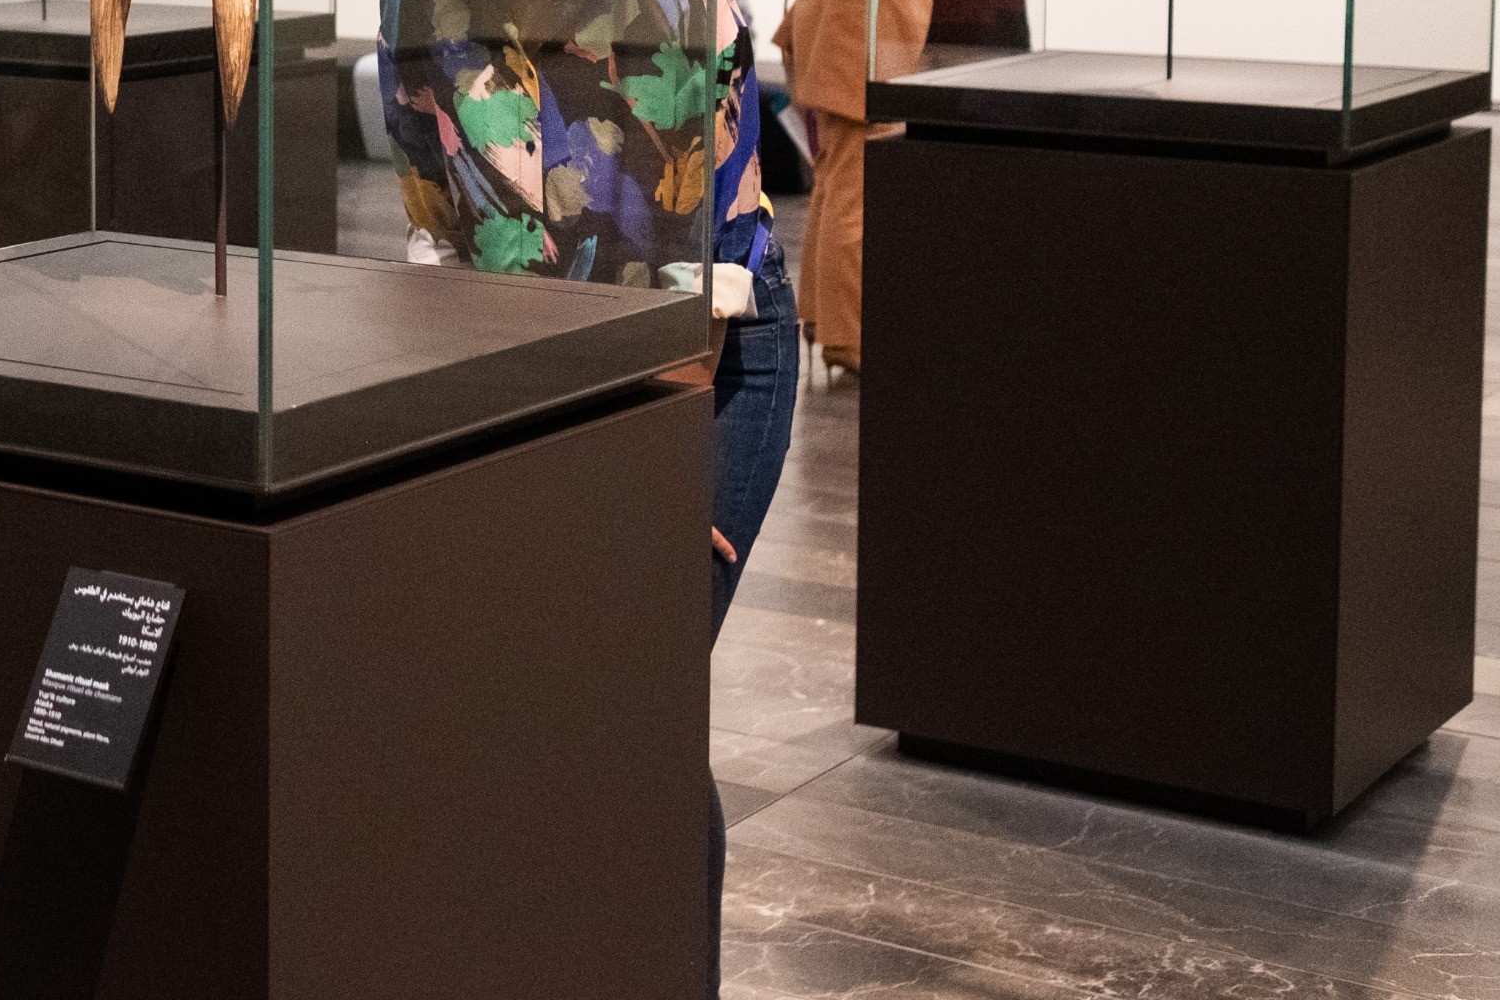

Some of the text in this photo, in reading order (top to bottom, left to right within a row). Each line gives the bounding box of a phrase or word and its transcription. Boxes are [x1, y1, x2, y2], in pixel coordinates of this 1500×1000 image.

[42, 678, 65, 689] Masque
[85, 688, 93, 696] de
[94, 690, 122, 703] chamane
[45, 669, 109, 691] Shamanic ritual mask
[56, 695, 75, 705] culture
